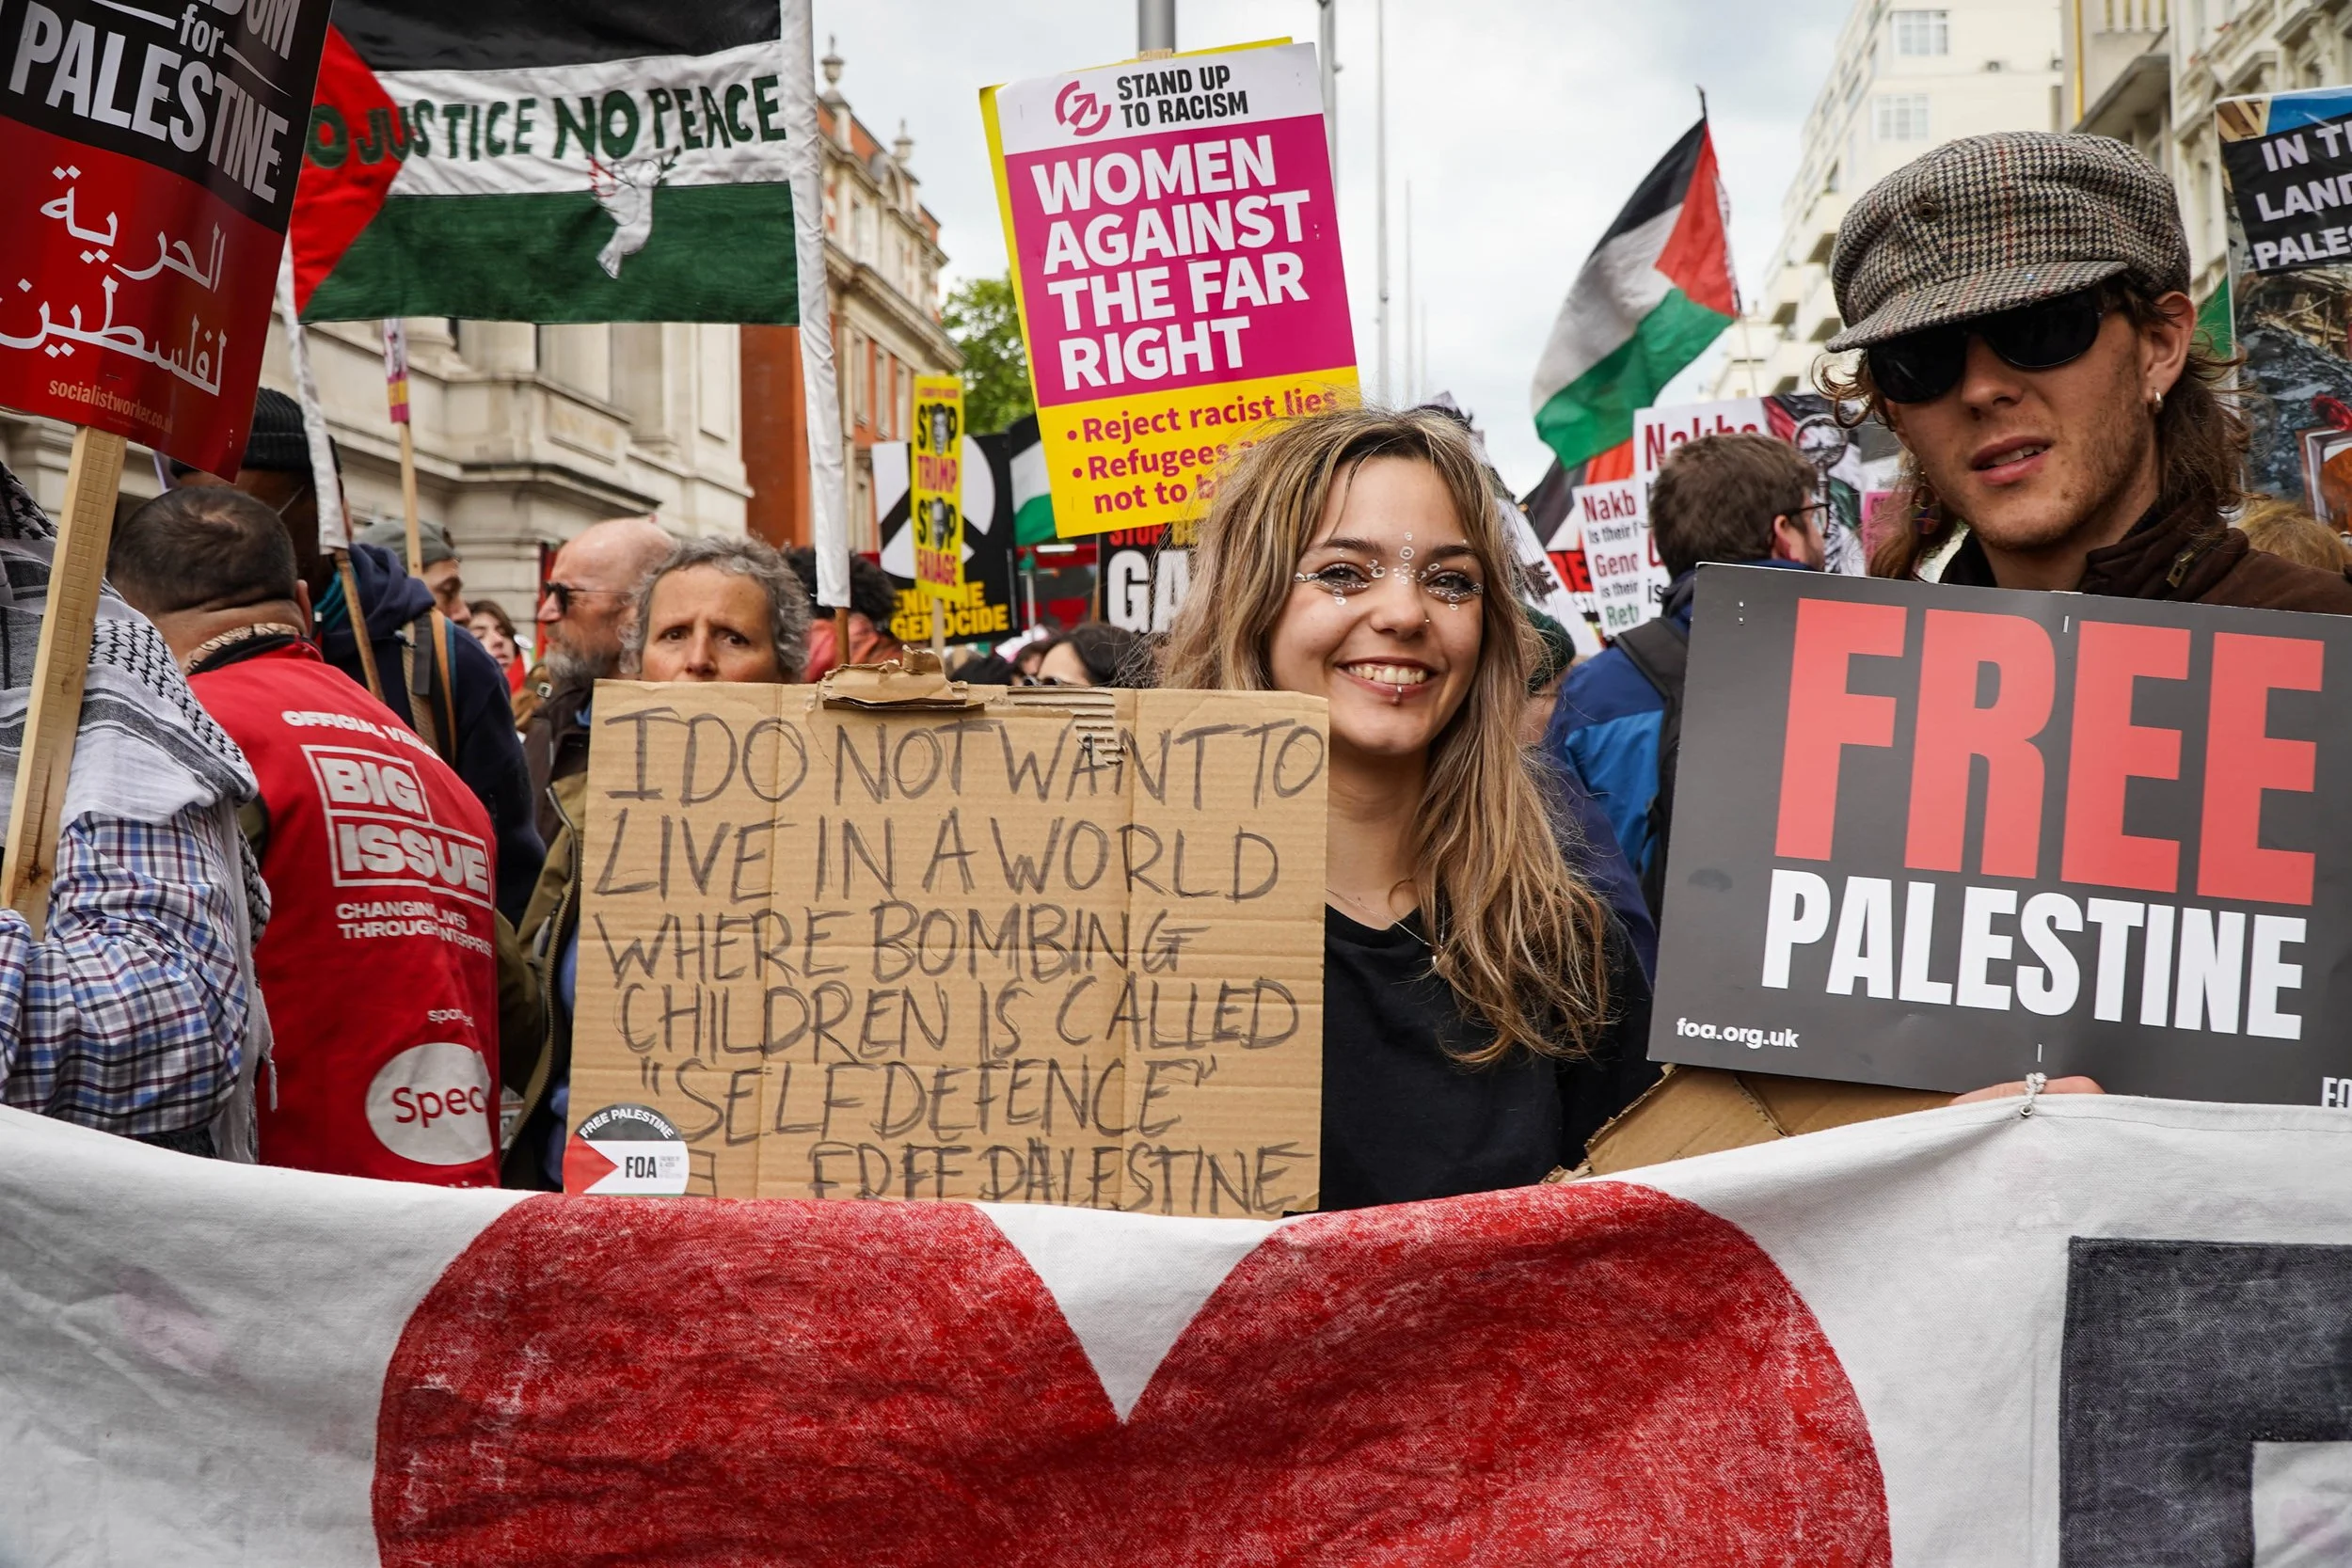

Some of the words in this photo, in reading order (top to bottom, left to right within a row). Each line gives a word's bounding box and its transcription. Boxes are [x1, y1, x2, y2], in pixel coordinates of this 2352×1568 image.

[179, 3, 225, 58] for
[8, 0, 289, 204] PALESTINE
[1117, 68, 1193, 101] STAND
[1200, 65, 1231, 91] UP
[1120, 103, 1151, 128] TO
[1158, 90, 1248, 124] RACISM
[305, 103, 348, 169] O
[355, 98, 537, 164] JUSTICE
[552, 89, 641, 160] NO
[646, 74, 787, 149] PEACE
[1030, 135, 1277, 215] WOMEN
[2261, 133, 2311, 173] IN
[40, 165, 226, 293] الحرية
[1042, 189, 1311, 276] AGAINST
[1047, 265, 1175, 332] THE
[1187, 251, 1311, 314] FAR
[1058, 316, 1250, 390] RIGHT
[917, 404, 958, 457] STP
[1082, 405, 1182, 443] Reject
[1189, 395, 1277, 429] racist
[1283, 388, 1338, 417] lies
[1088, 444, 1231, 481] Refugees
[917, 497, 958, 551] STP
[1094, 483, 1148, 515] not
[1154, 483, 1188, 505] to
[1582, 489, 1636, 523] Nakb
[890, 604, 1009, 641] GENOCIDE
[281, 710, 388, 740] OFFICIAL
[1774, 597, 2325, 907] FREE
[605, 706, 679, 801] I
[679, 712, 808, 808] DO
[834, 719, 999, 806] NOT
[998, 716, 1248, 811] WANT
[1242, 718, 1326, 810] TO
[316, 757, 426, 816] BIG
[337, 823, 489, 895] ISSUE
[593, 807, 798, 905] LIVE
[815, 815, 898, 902] IN
[921, 806, 977, 895] A
[989, 816, 1279, 904] WORLD
[336, 900, 437, 920] CHANGIN
[593, 907, 855, 990] WHERE
[869, 899, 1212, 984] BOMBING
[1761, 868, 2307, 1040] PALESTINE
[614, 980, 949, 1064] CHILDREN
[977, 976, 1035, 1063] IS
[1056, 972, 1300, 1052] CALLED
[1676, 1017, 1799, 1050] foa.org.uk
[391, 1085, 486, 1129] Spec
[2321, 1076, 2352, 1108] FO
[580, 1113, 611, 1139] FREE
[611, 1109, 675, 1139] PALESTINE
[626, 1156, 657, 1179] FOA
